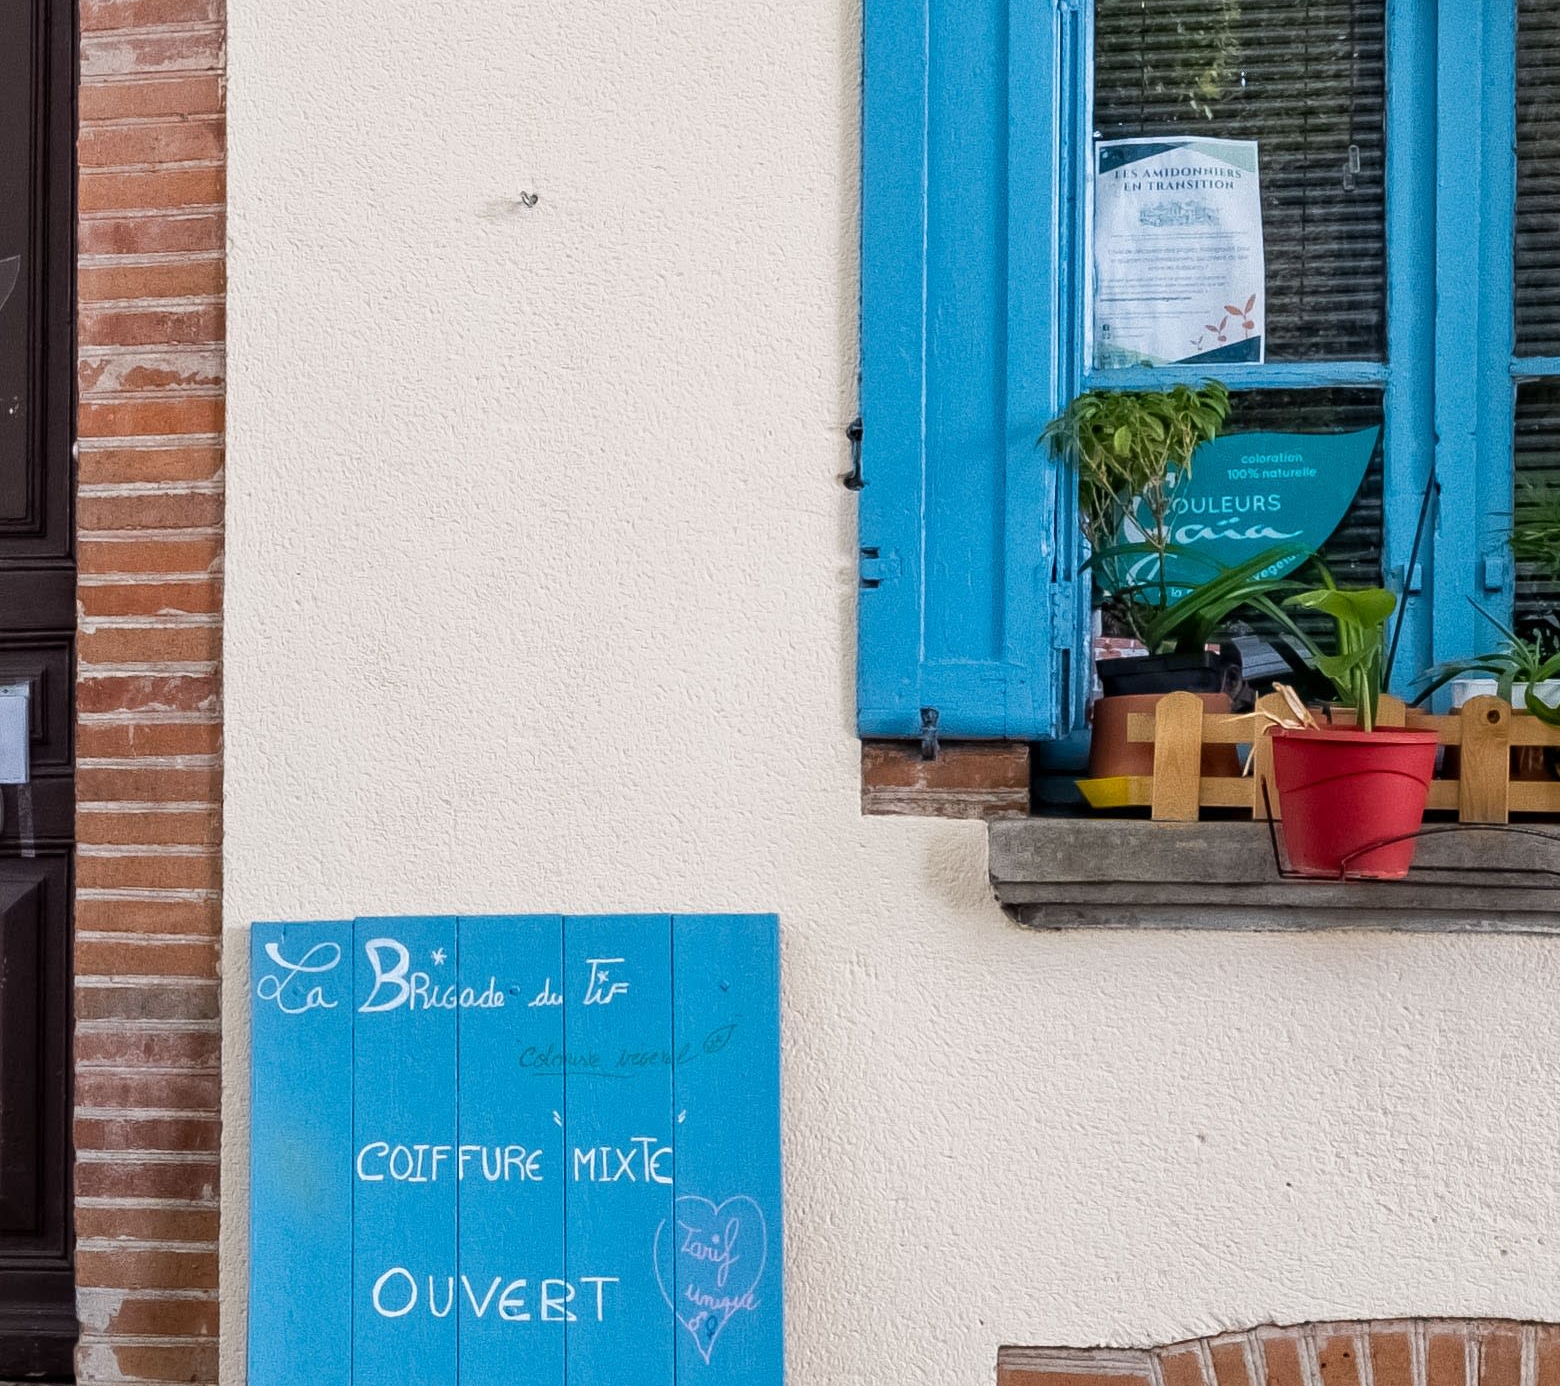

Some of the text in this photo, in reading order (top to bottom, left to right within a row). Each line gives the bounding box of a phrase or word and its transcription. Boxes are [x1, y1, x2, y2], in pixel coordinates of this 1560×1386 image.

[1124, 180, 1234, 192] EN TRANSITION
[1143, 166, 1242, 179] AMIDONNIERS
[1227, 467, 1317, 480] 100% naturelle
[1241, 453, 1303, 464] coloration
[527, 977, 564, 1008] du
[356, 1140, 545, 1183] COIFFURE
[678, 1217, 740, 1288] Tarif
[372, 1266, 621, 1323] OUVERT
[685, 1284, 762, 1315] unique
